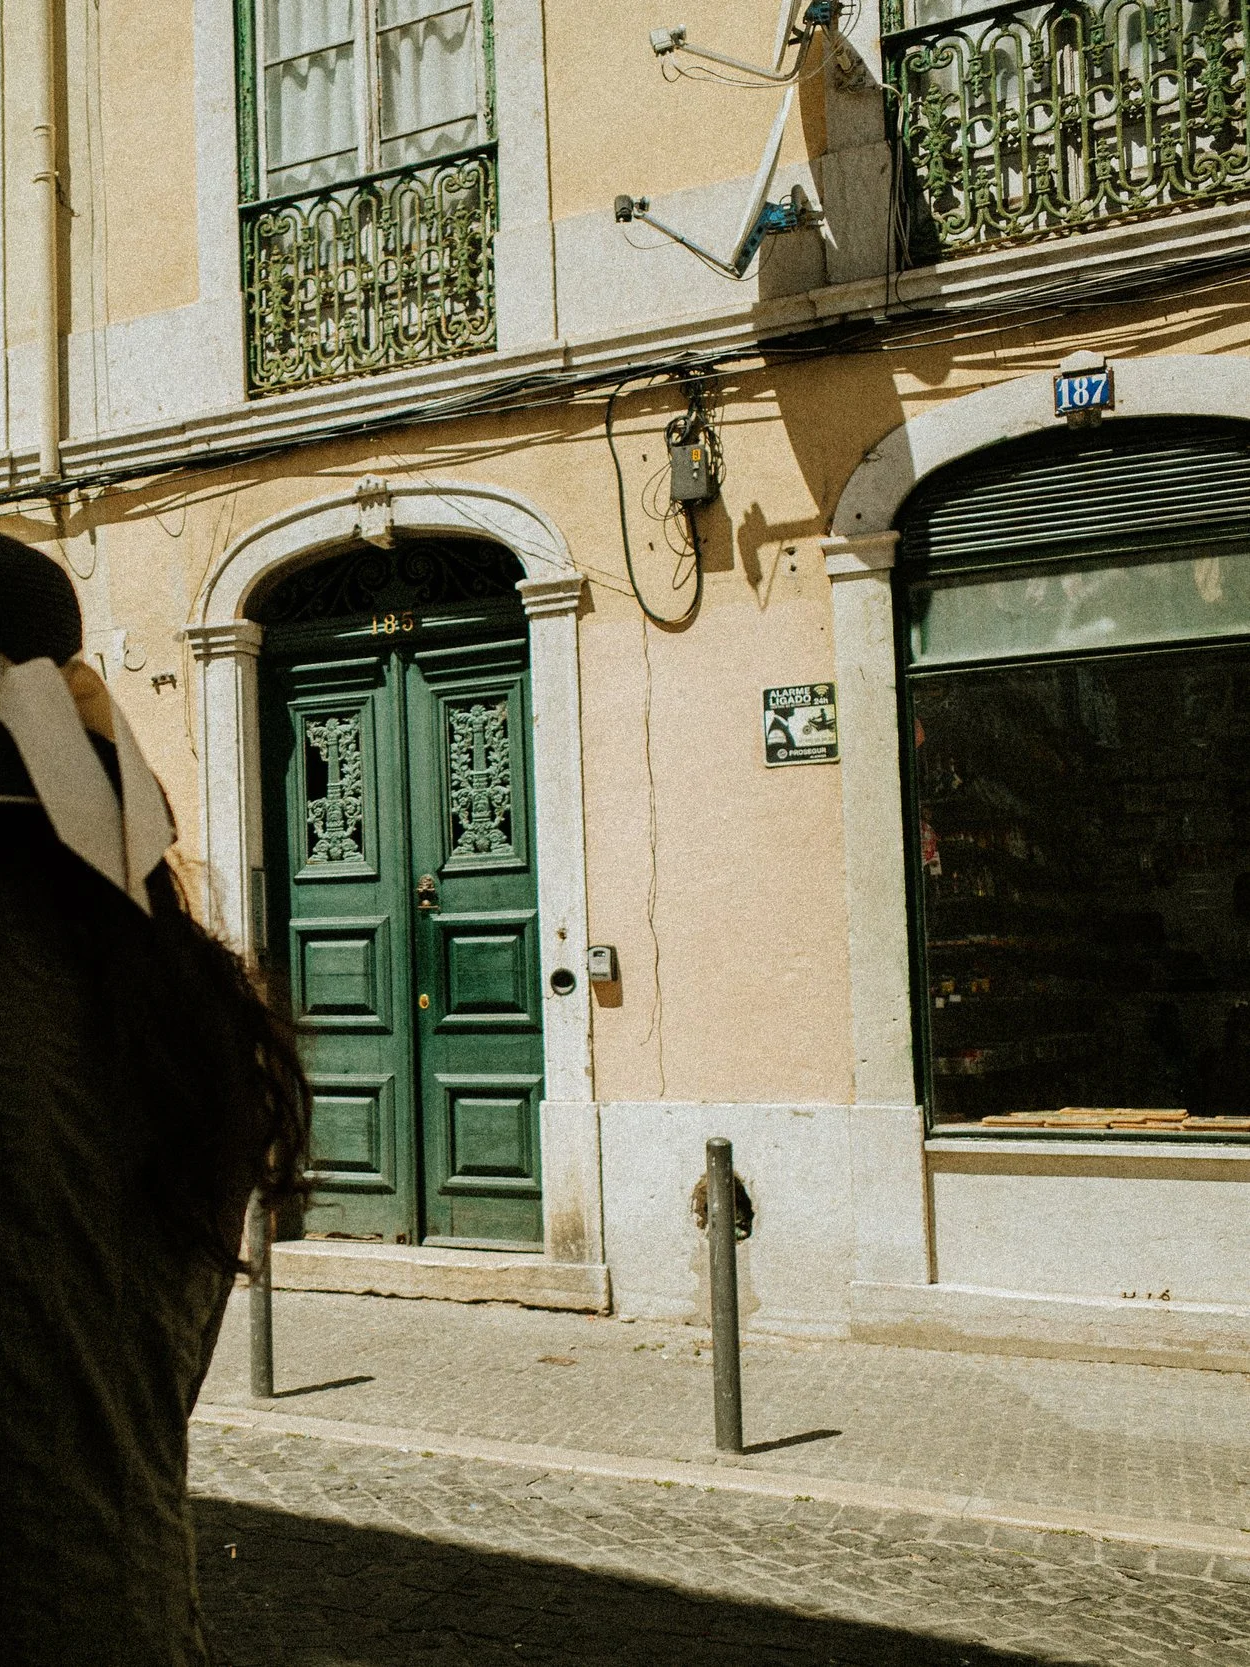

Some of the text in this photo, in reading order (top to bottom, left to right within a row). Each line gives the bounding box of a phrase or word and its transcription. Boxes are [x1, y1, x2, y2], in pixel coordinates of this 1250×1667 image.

[1058, 374, 1107, 408] 187
[371, 611, 414, 635] 185
[770, 687, 810, 698] ALARME
[770, 695, 811, 706] LIGADO
[813, 697, 829, 705] 24h
[789, 747, 827, 756] PROSEGUR
